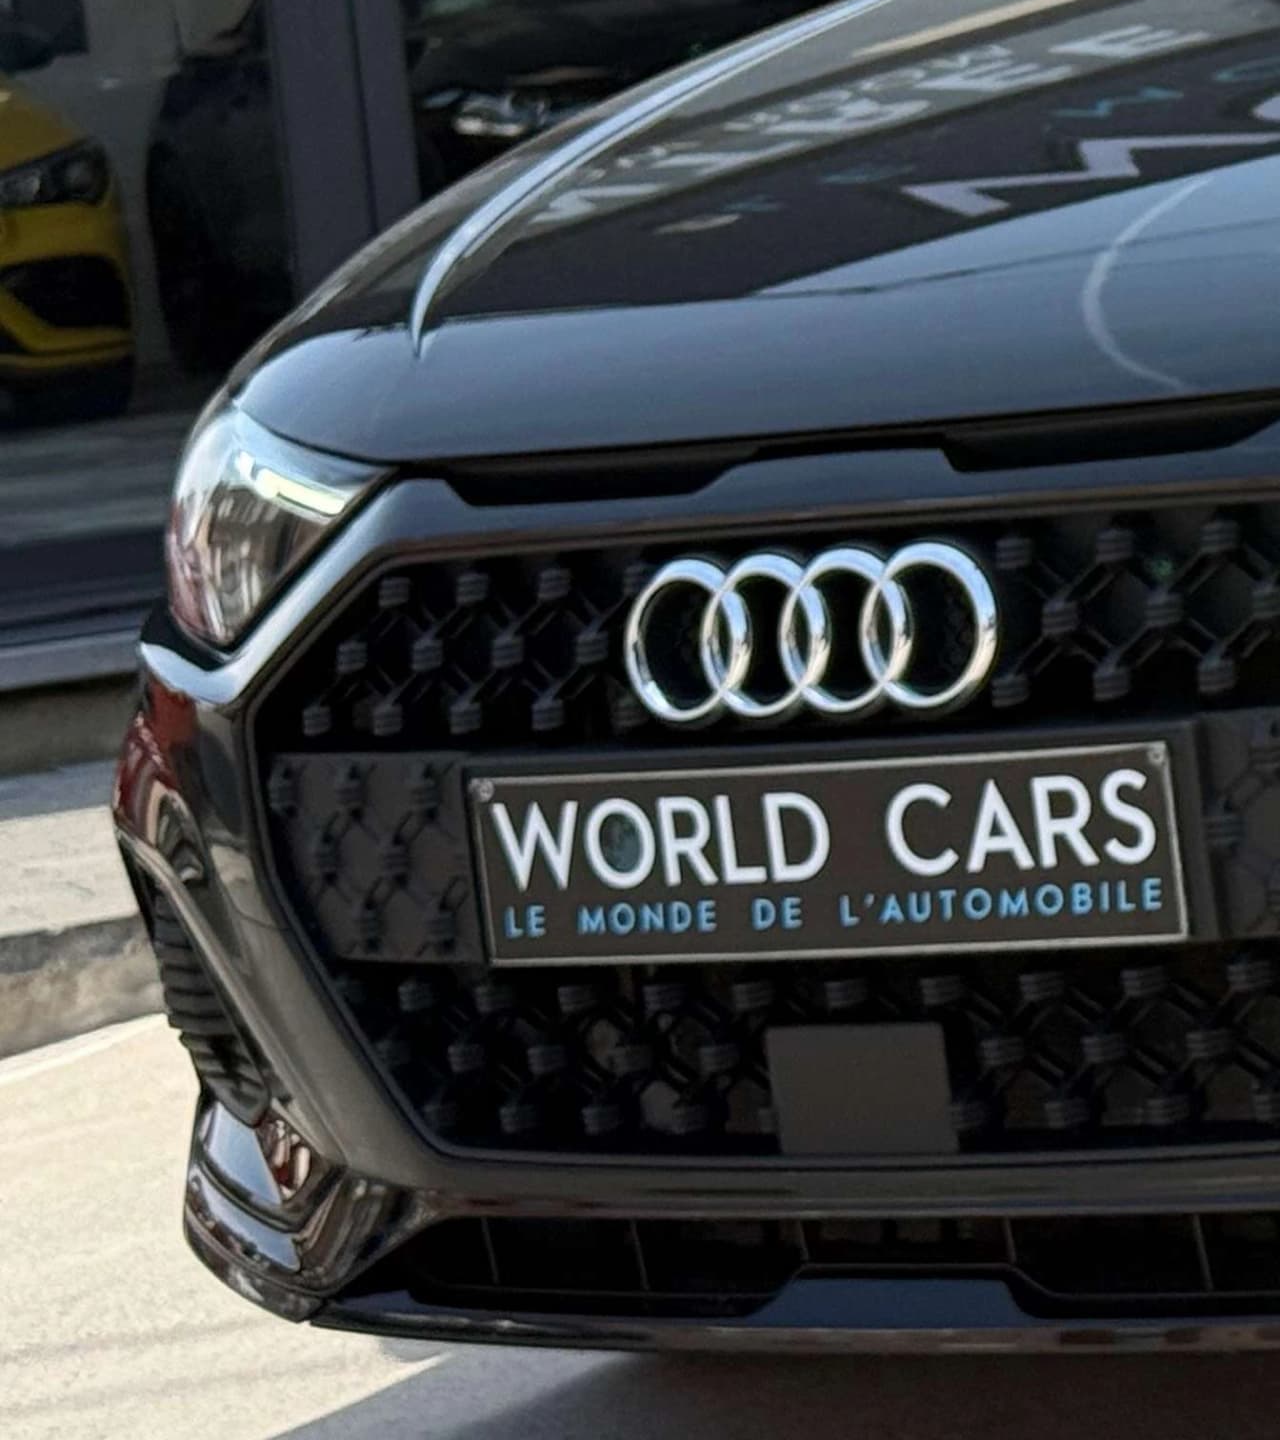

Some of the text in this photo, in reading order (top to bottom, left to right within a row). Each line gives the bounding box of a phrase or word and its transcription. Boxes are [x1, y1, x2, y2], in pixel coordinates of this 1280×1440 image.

[490, 766, 1157, 893] WORLD CARS
[503, 877, 1164, 939] LE MONDE DE L'AUTOMOBILE
